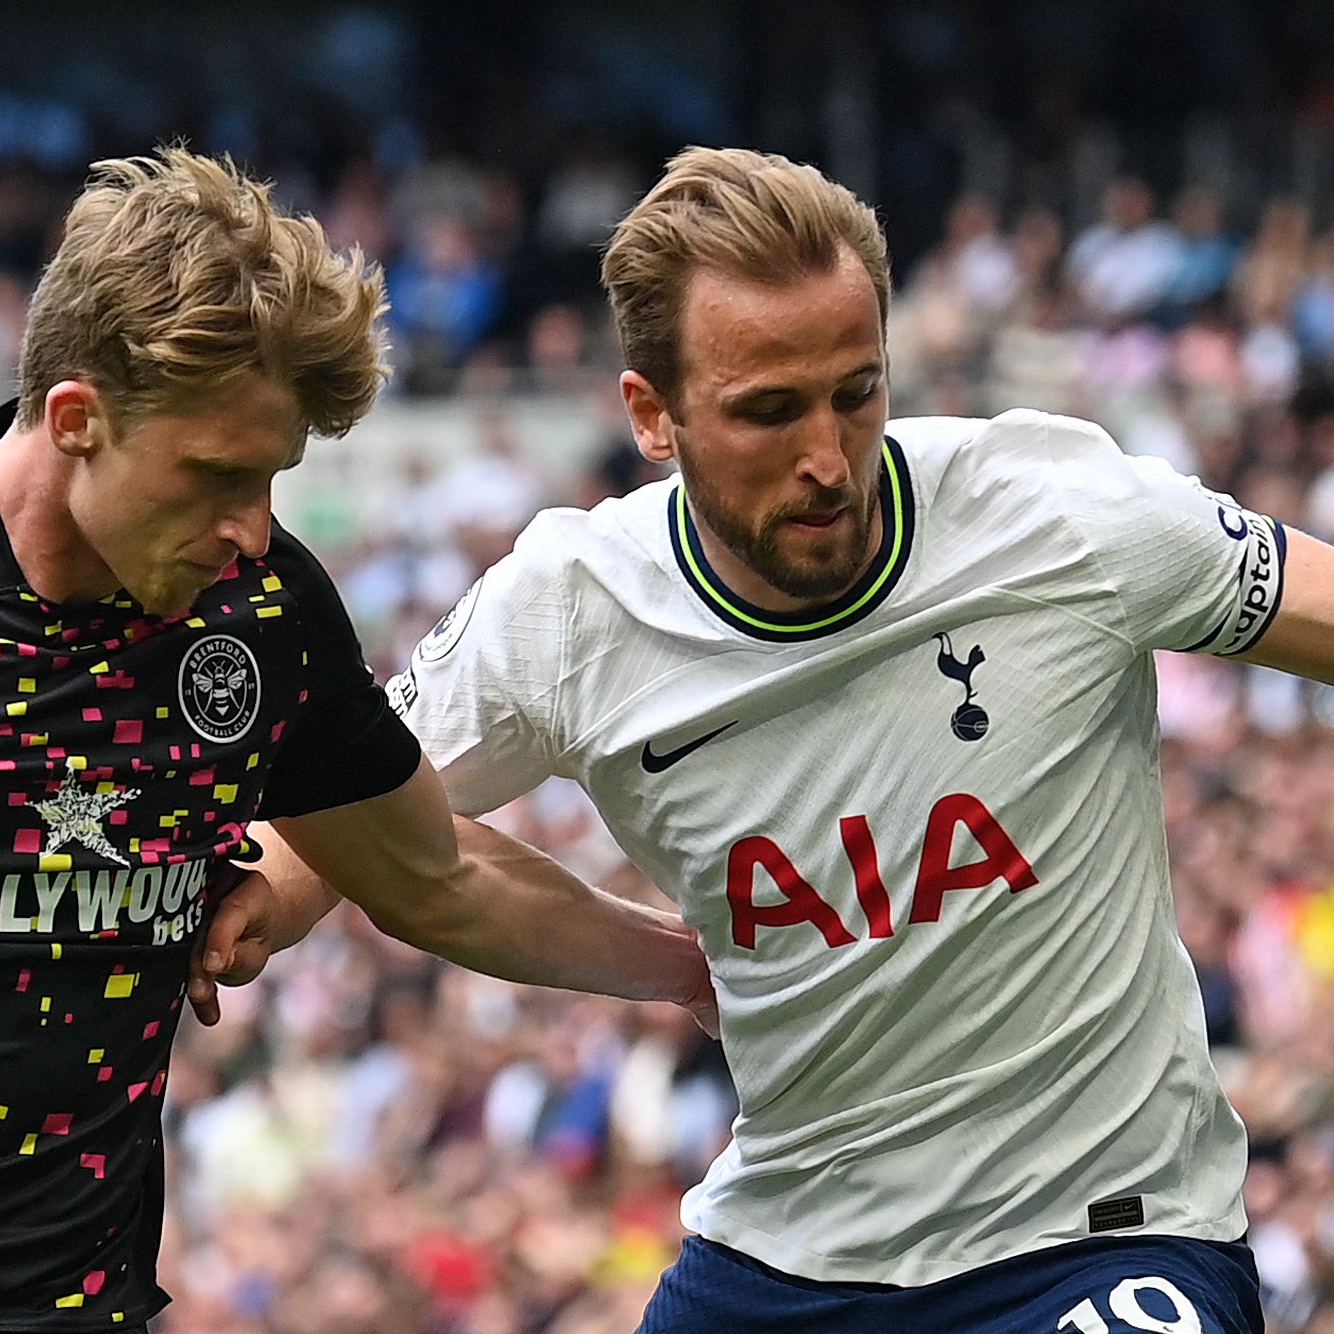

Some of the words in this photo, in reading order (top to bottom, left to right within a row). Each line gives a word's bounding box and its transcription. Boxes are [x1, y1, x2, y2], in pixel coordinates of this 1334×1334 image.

[189, 641, 246, 669] BRENTFORD
[726, 793, 1040, 950] AIA
[152, 899, 204, 945] bets
